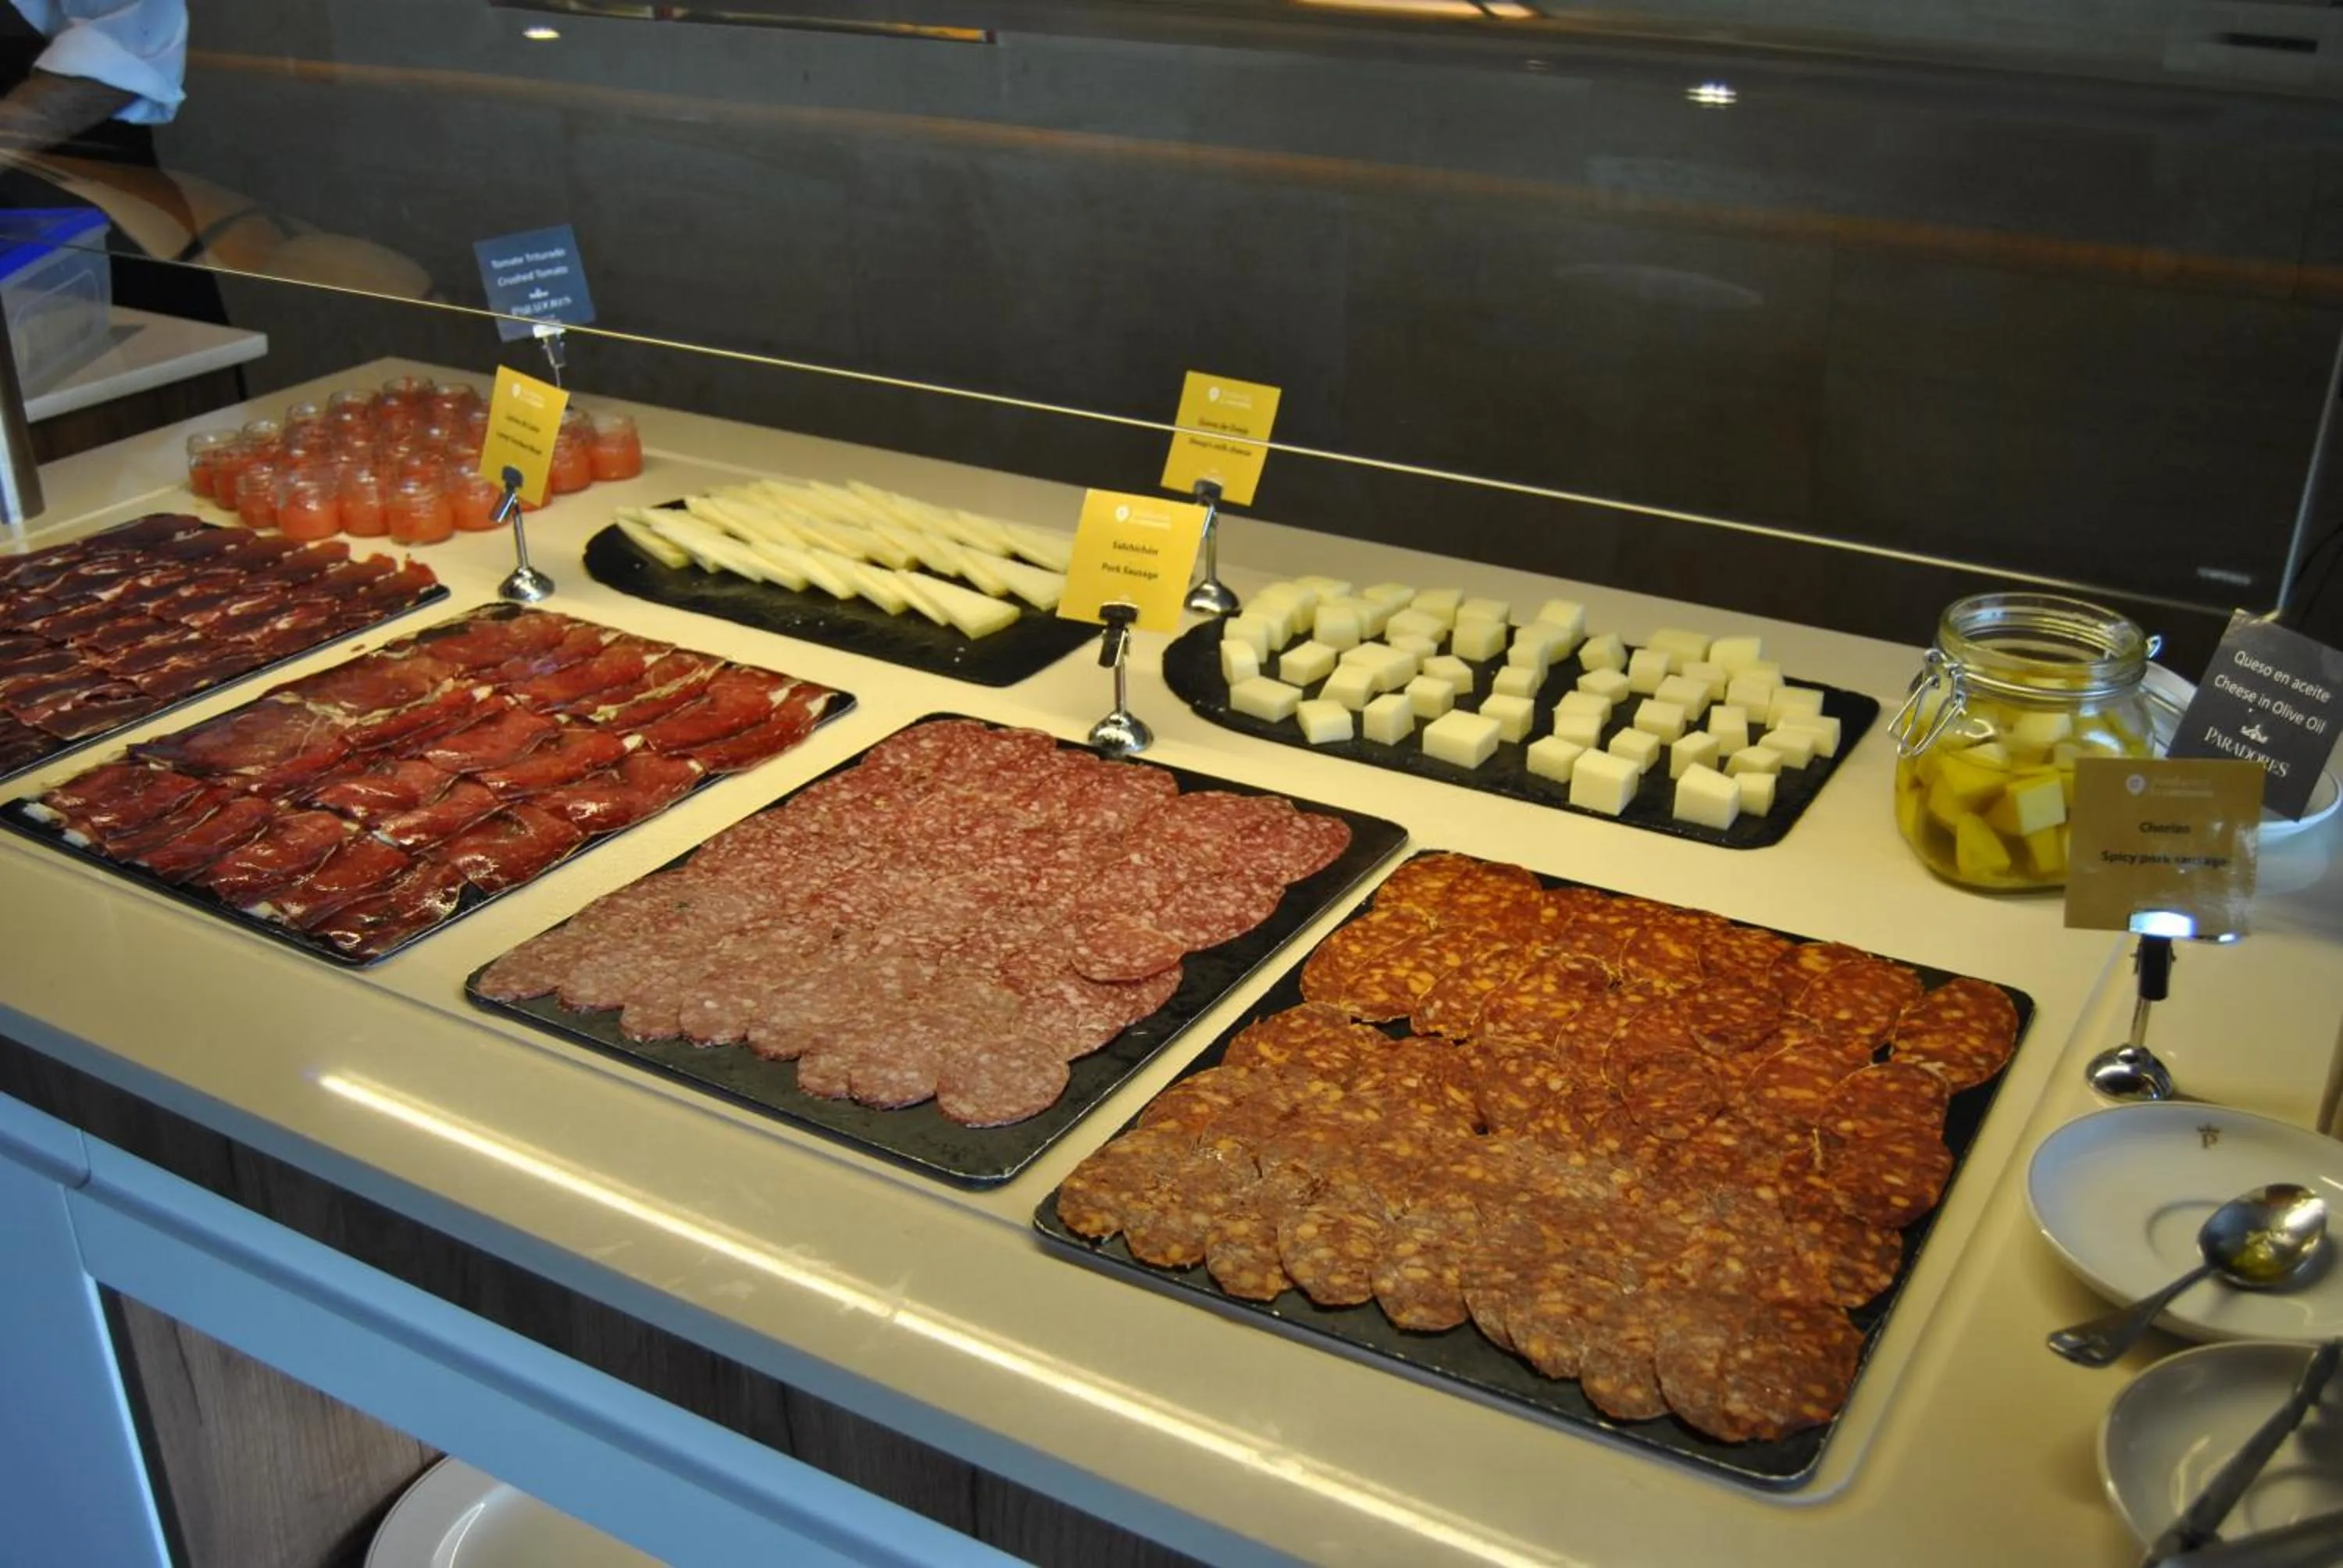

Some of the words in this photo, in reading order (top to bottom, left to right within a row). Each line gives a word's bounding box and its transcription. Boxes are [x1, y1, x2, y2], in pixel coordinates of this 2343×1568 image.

[1123, 565, 1159, 581] Sausage
[2234, 650, 2272, 677] Queso
[2273, 670, 2290, 685] en
[2291, 677, 2331, 703] aceite
[2214, 674, 2256, 702] Cheese
[2258, 696, 2270, 710] in
[2272, 700, 2305, 725] Olive
[2306, 715, 2326, 736] Oil
